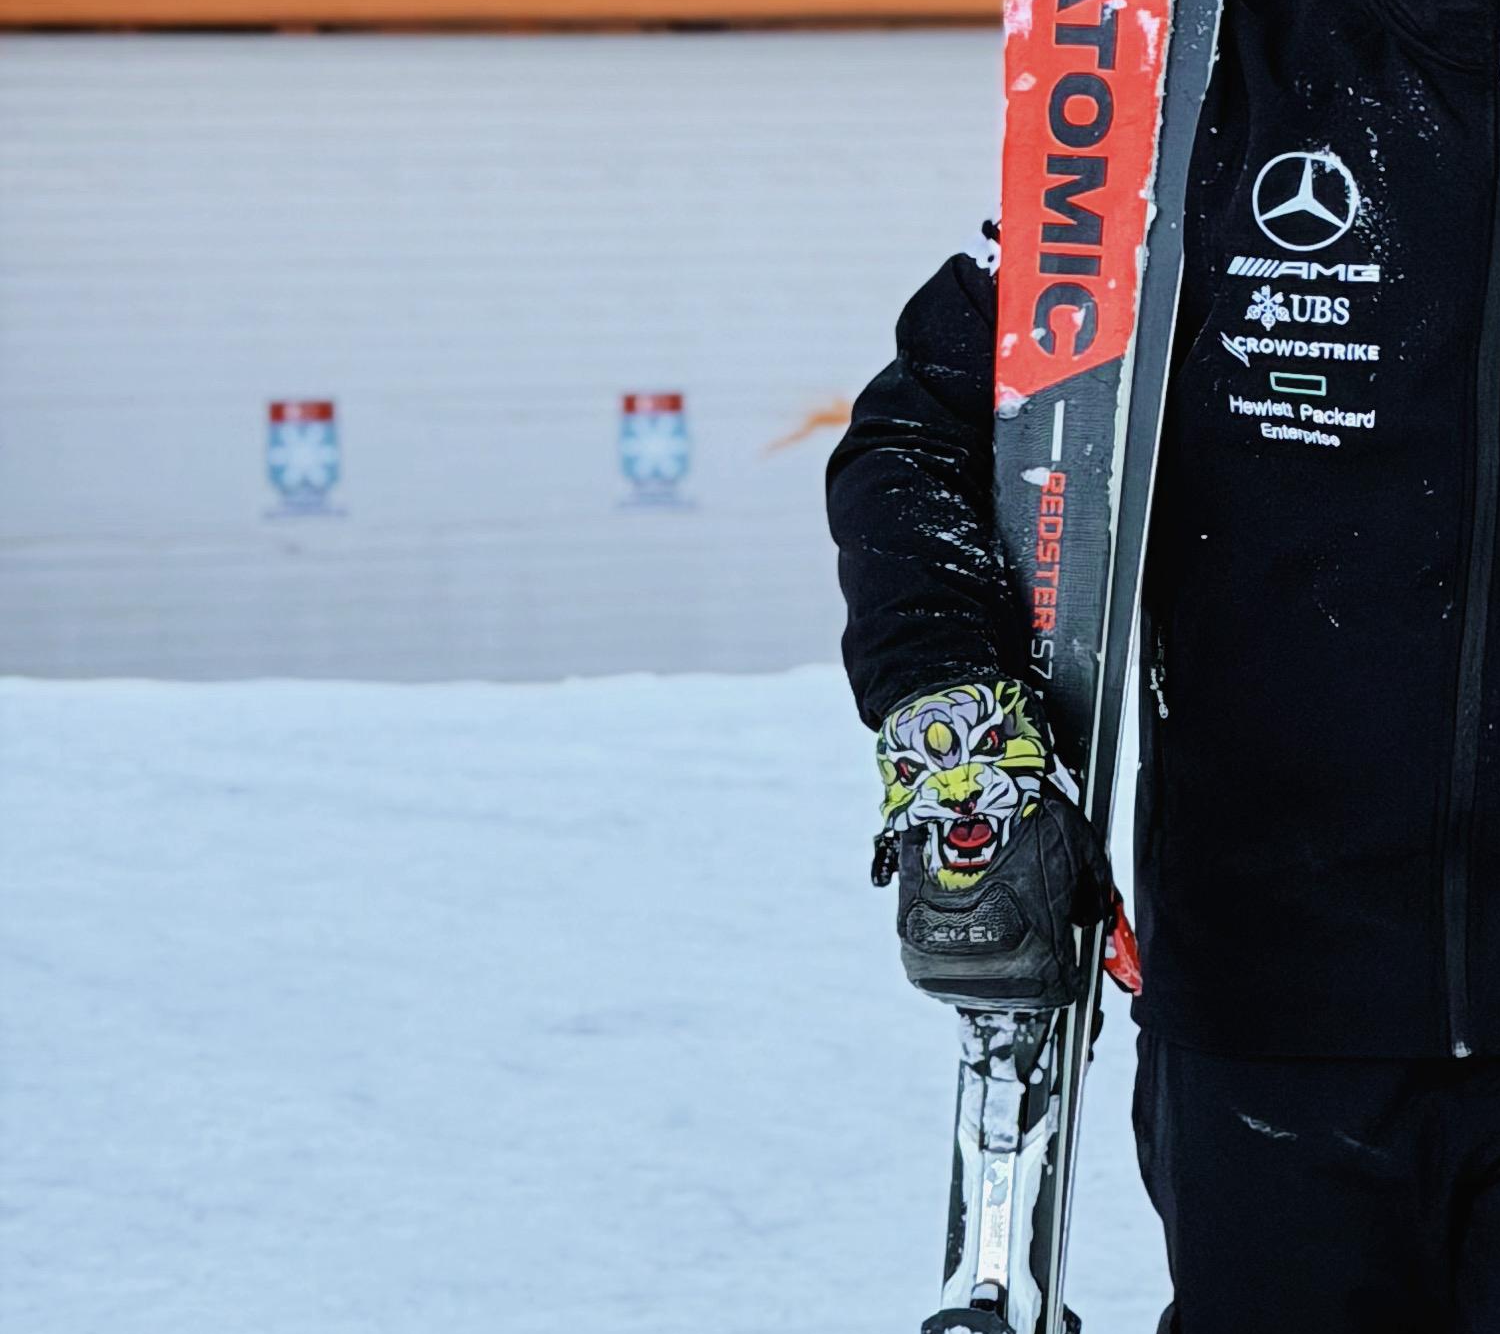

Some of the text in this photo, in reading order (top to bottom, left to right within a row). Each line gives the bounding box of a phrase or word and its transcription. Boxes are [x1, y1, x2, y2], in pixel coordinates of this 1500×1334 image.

[1274, 261, 1380, 282] AMG
[1290, 294, 1350, 325] UBS
[1233, 336, 1380, 361] CROWDSTRIKE
[1229, 394, 1375, 428] Hewlett Packard
[1260, 422, 1341, 447] Enterprise
[1029, 471, 1067, 680] REDSTER S7
